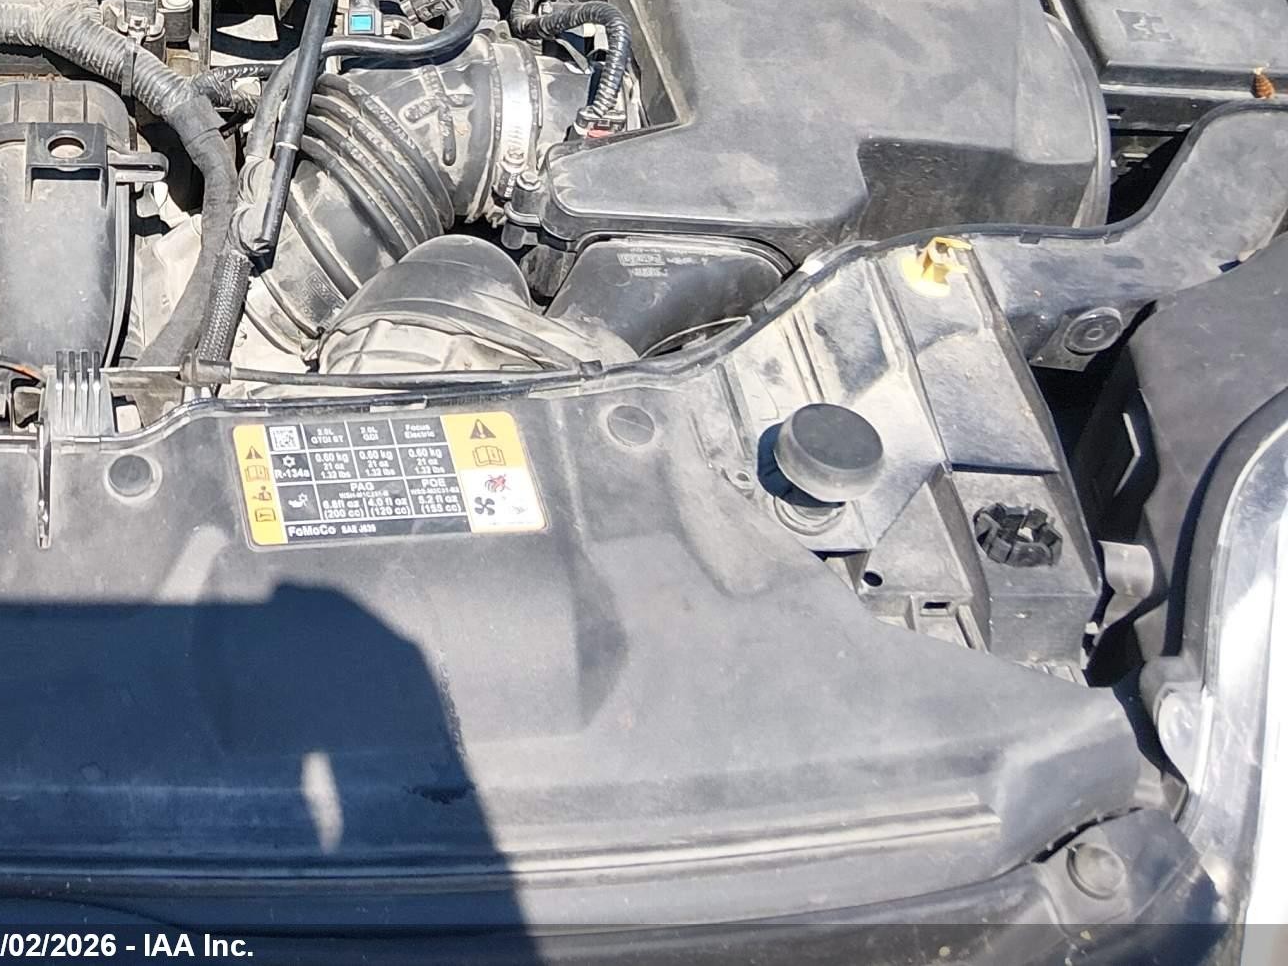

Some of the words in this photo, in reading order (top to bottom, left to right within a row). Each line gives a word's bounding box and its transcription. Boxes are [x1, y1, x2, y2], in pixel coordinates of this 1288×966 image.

[315, 452, 335, 462] 0.60
[336, 451, 350, 463] kg
[359, 450, 379, 460] 0.60
[380, 449, 393, 461] kg
[408, 448, 428, 458] 0.60
[429, 447, 443, 458] kg
[350, 482, 375, 492] PAG
[421, 478, 447, 488] POE
[394, 497, 408, 506] oz
[370, 506, 393, 517] (120
[394, 505, 411, 516] cc)
[445, 502, 462, 513] cc)
[324, 509, 346, 520] (200
[347, 508, 364, 518] cc)
[287, 524, 337, 537] FoMoCo
